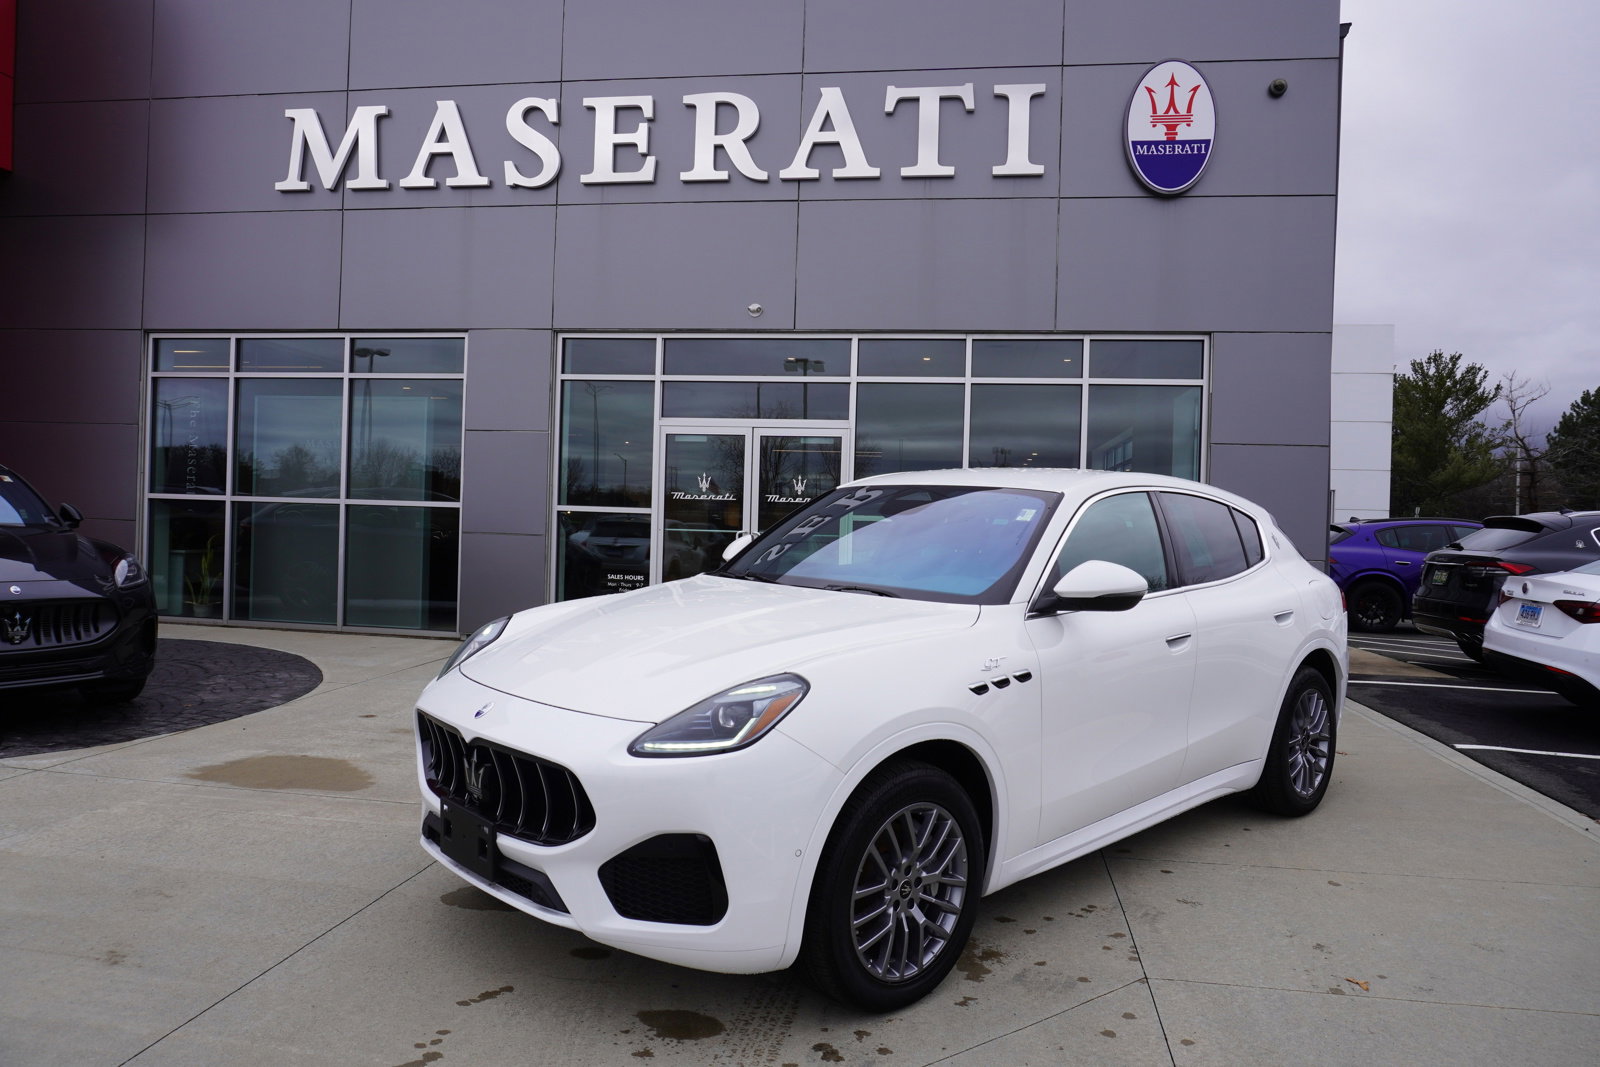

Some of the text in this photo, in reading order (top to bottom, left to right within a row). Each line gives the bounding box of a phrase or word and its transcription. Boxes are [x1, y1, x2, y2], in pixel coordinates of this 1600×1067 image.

[275, 83, 1047, 192] MASERATI
[1136, 143, 1207, 155] MASERATI
[671, 491, 737, 501] Maserati
[765, 494, 811, 503] Maser
